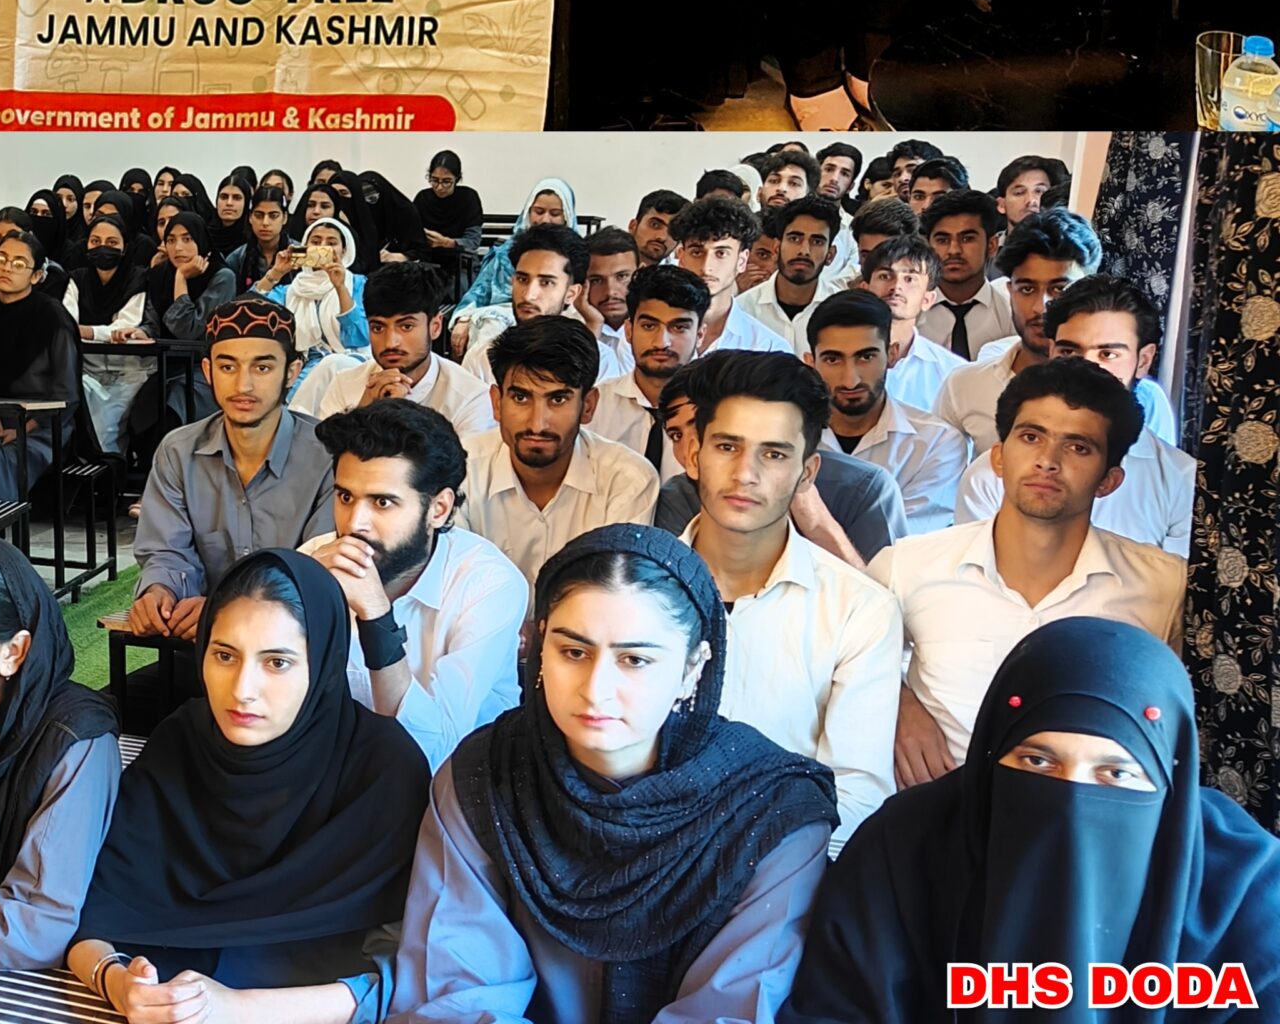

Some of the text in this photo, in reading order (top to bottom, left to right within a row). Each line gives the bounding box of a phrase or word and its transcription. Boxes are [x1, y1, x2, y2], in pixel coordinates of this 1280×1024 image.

[36, 14, 439, 47] JAMMU AND KASHMIR
[147, 106, 174, 129] of
[180, 106, 275, 129] Jammu
[282, 106, 300, 129] &
[308, 106, 415, 130] Kashmir
